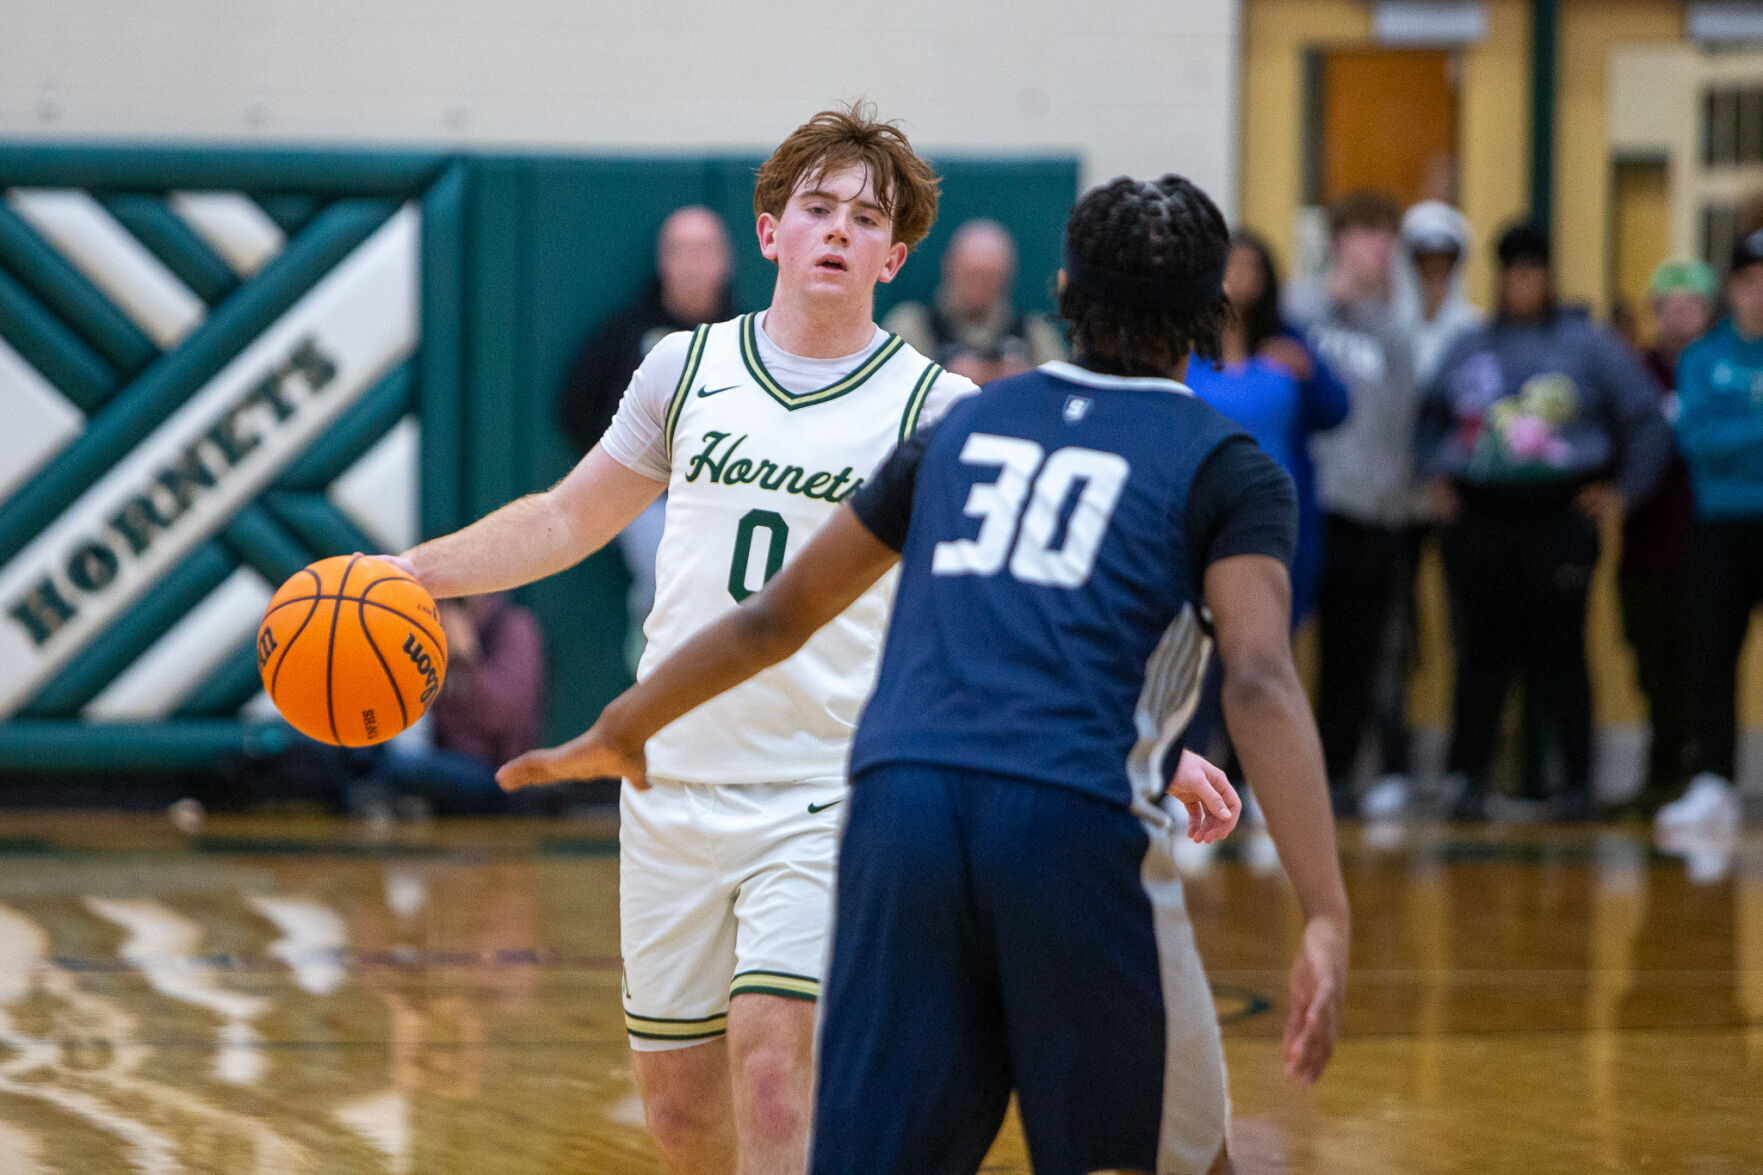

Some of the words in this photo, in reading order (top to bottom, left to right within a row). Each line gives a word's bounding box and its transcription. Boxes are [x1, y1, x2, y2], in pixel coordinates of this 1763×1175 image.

[6, 332, 338, 647] HORNETS
[727, 508, 789, 604] 0
[931, 432, 1131, 589] 30
